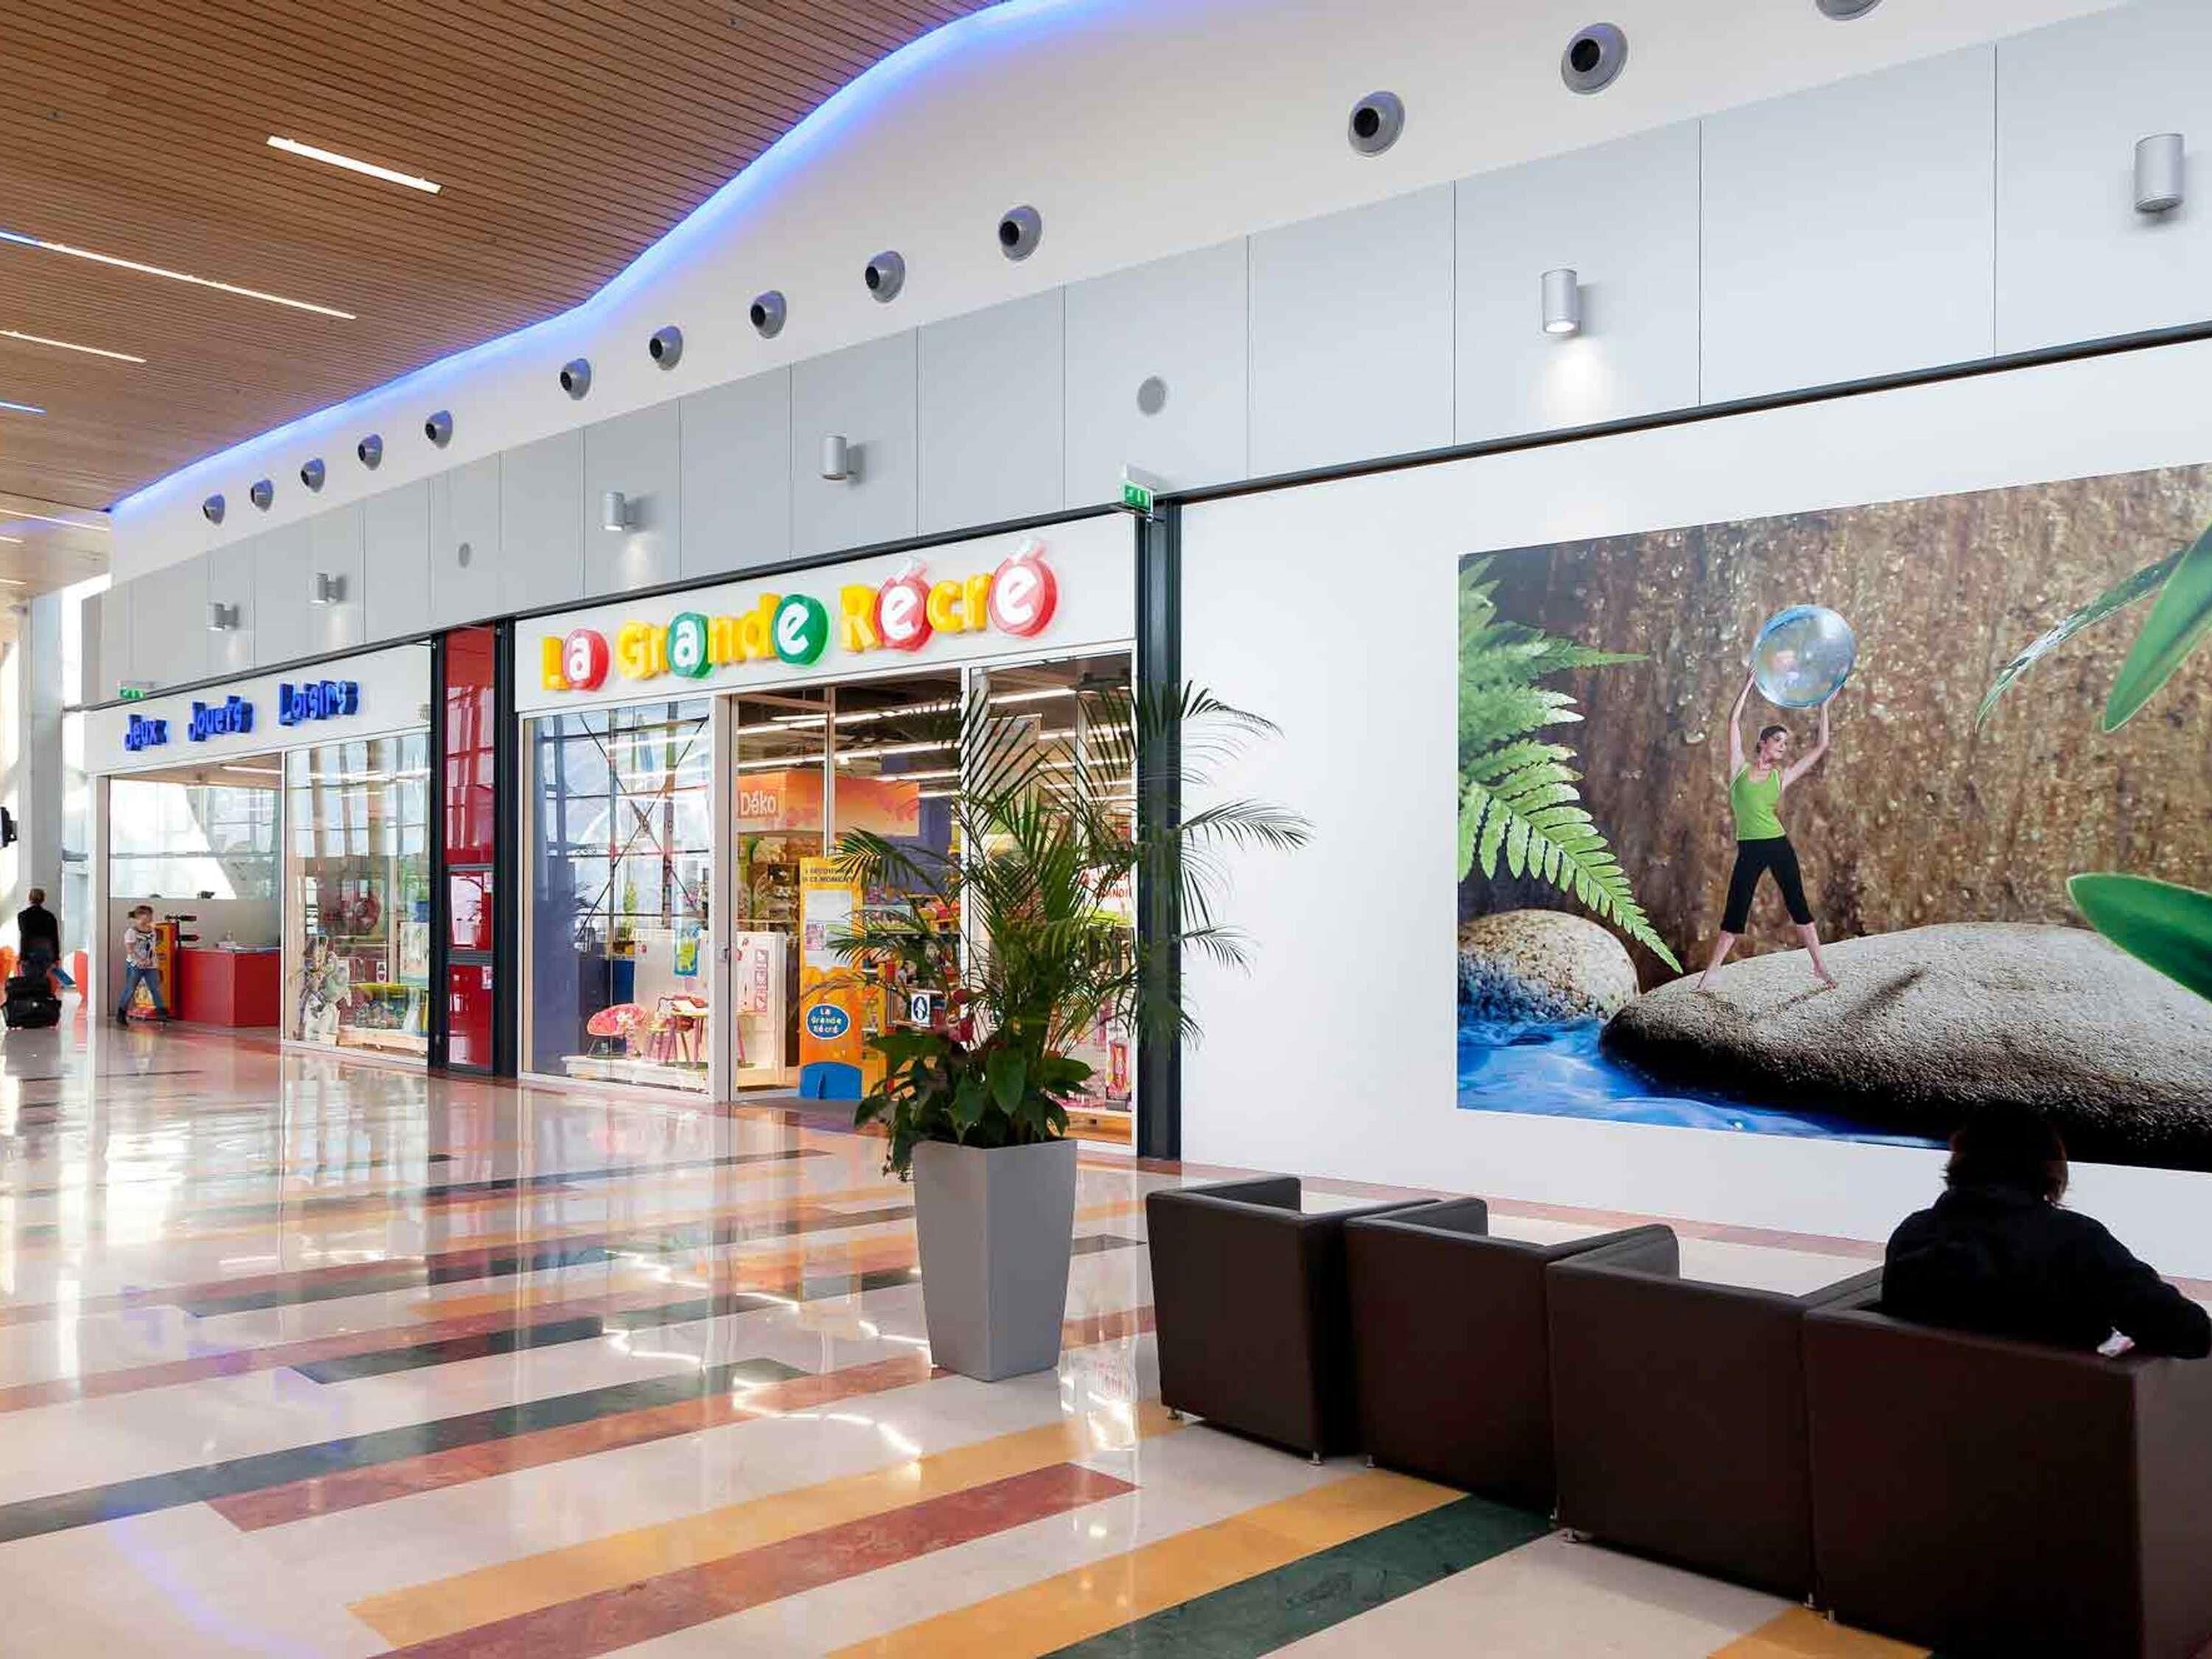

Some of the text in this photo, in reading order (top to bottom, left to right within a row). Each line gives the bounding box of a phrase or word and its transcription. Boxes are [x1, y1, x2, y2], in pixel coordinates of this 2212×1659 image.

[542, 539, 1057, 691] La Grande Récré
[125, 680, 359, 751] Jeux Jouets Loisirs
